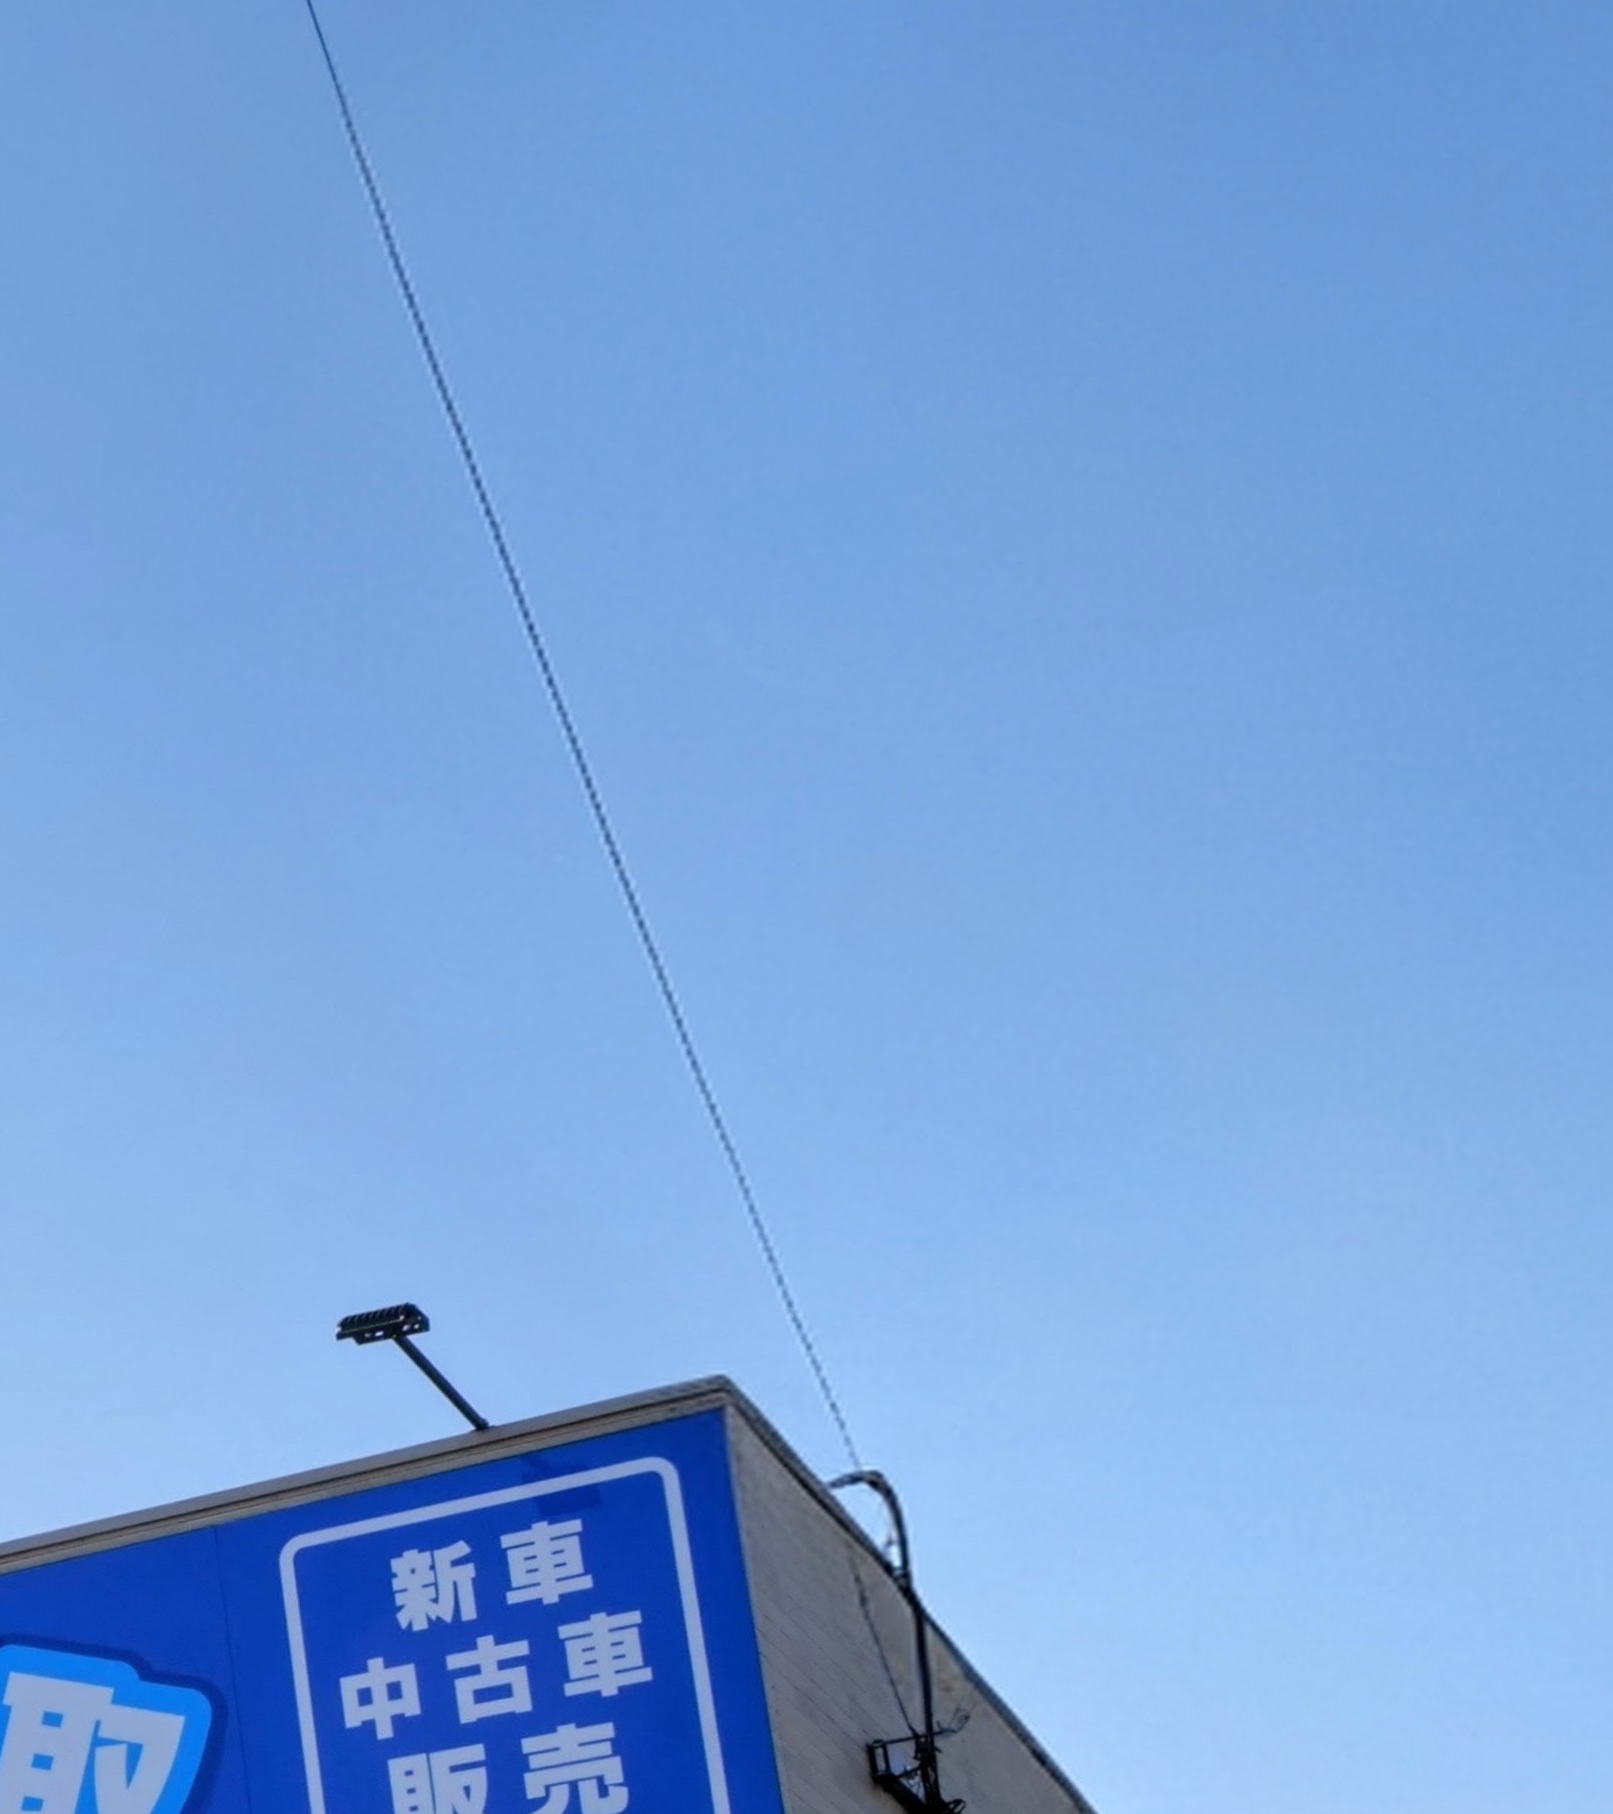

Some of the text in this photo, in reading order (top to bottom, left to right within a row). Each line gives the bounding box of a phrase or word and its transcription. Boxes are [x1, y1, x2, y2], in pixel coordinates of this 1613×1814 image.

[390, 1518, 594, 1633] 新車
[339, 1609, 653, 1741] 中古車
